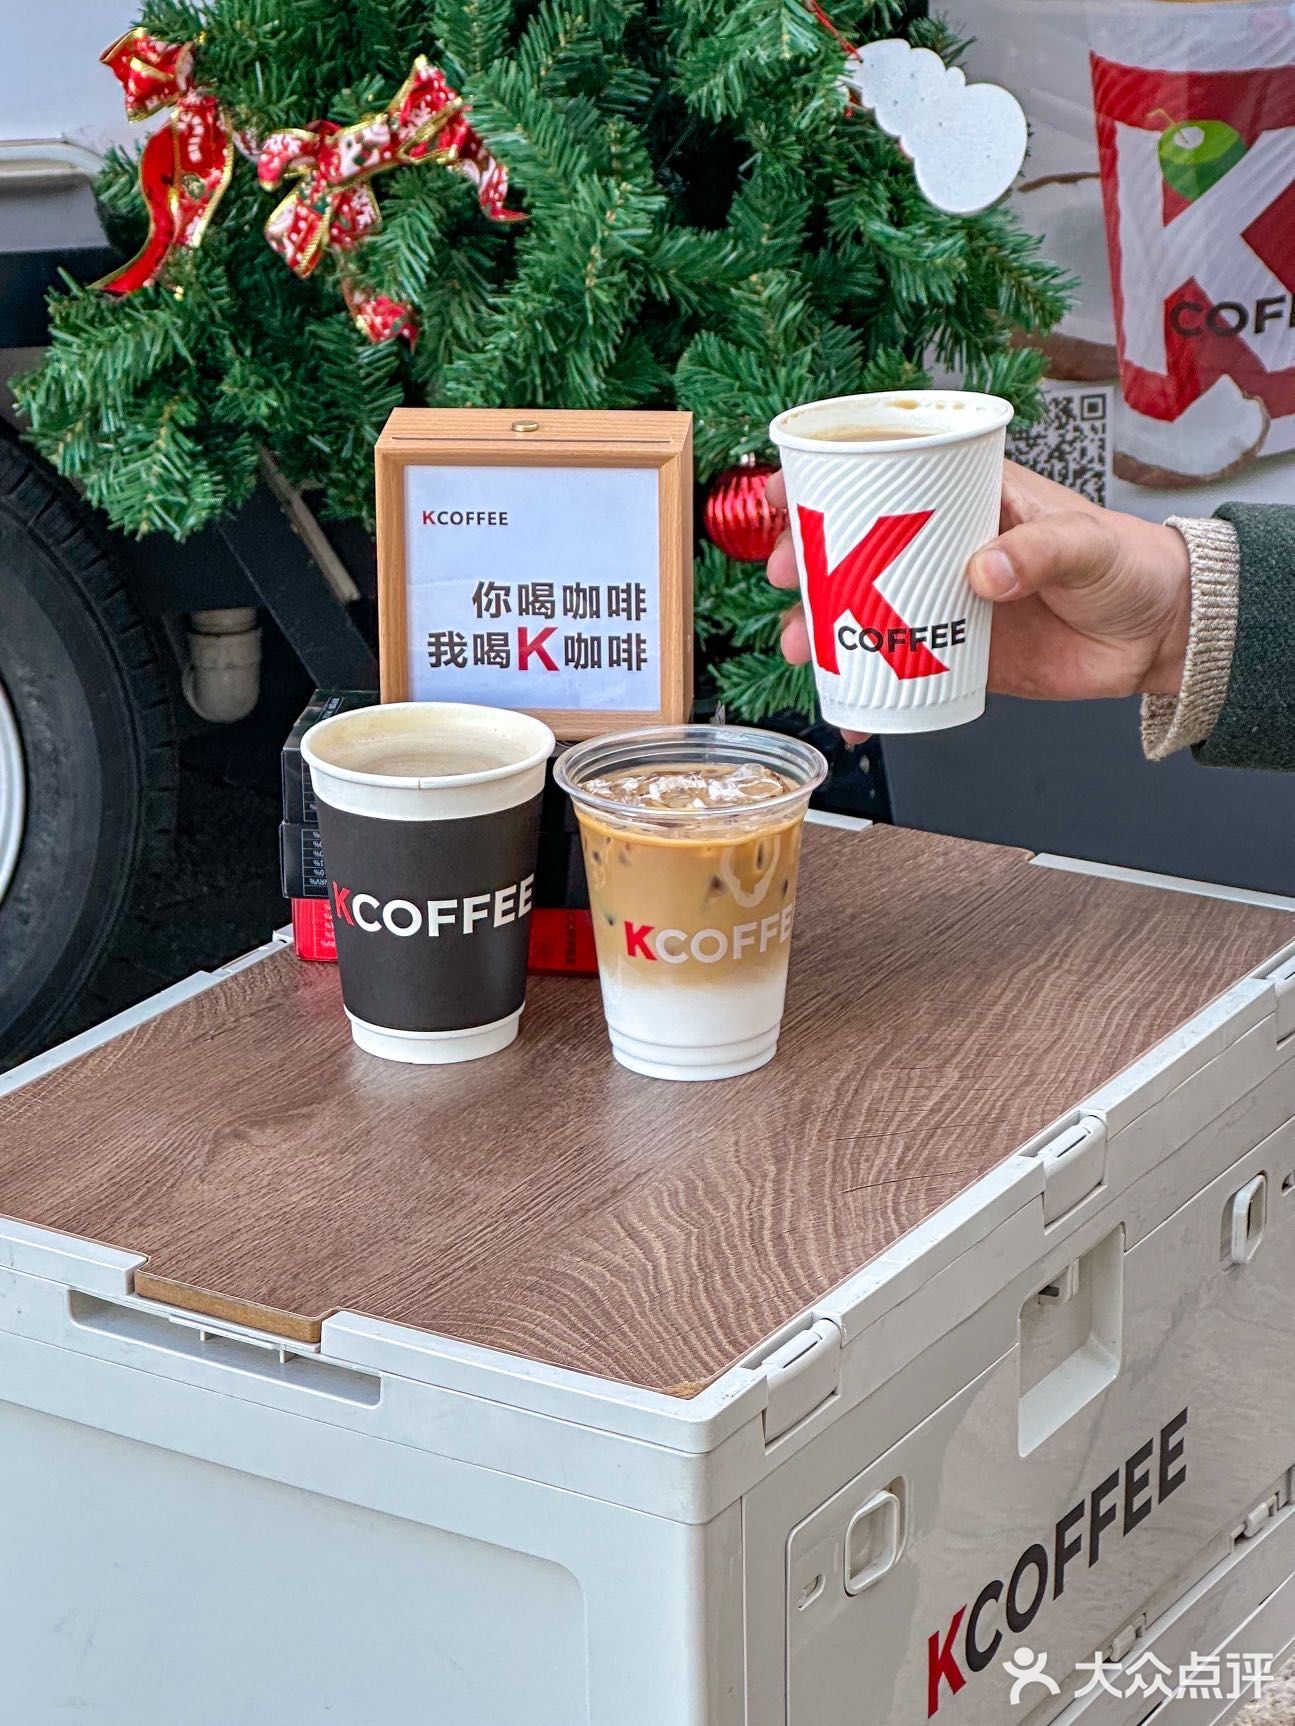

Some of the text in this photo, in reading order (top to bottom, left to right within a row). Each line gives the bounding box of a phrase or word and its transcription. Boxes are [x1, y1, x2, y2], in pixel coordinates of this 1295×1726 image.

[422, 510, 509, 526] KCOFFEE
[472, 581, 648, 621] 你喝咖啡
[797, 503, 950, 680] K
[427, 626, 648, 672] 我喝K咖啡
[837, 618, 966, 653] COFFEE
[332, 872, 535, 937] KCOFFEE
[927, 1406, 1189, 1720] KCOFFEE
